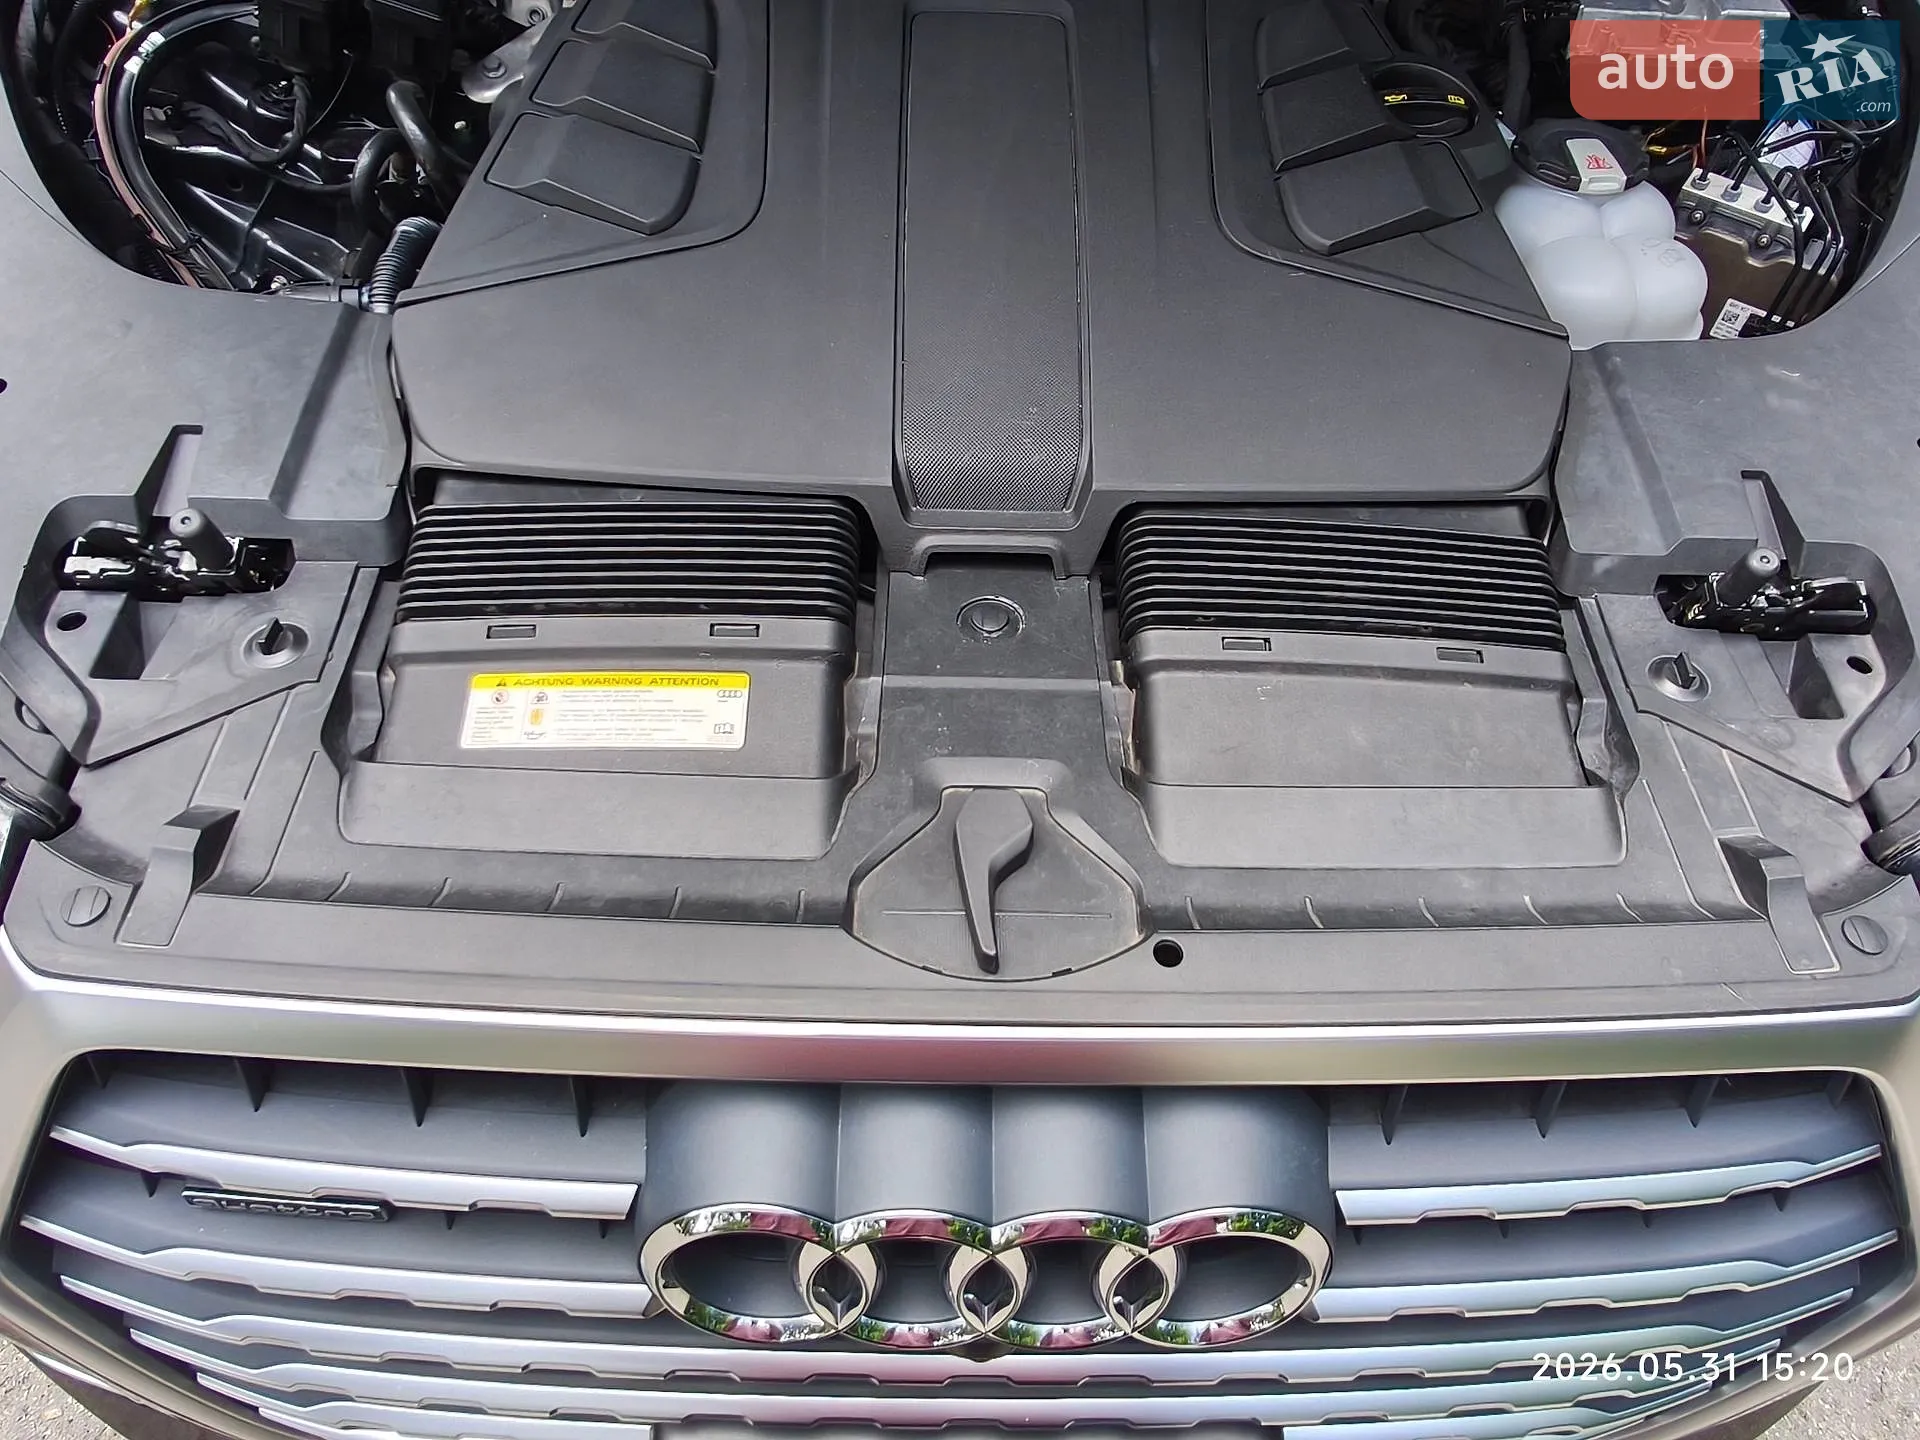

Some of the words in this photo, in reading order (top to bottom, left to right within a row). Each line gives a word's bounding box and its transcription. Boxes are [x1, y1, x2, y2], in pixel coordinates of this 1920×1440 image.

[513, 676, 575, 687] ACHTUNG
[581, 676, 643, 686] WARNING
[649, 676, 720, 687] ATTENTION
